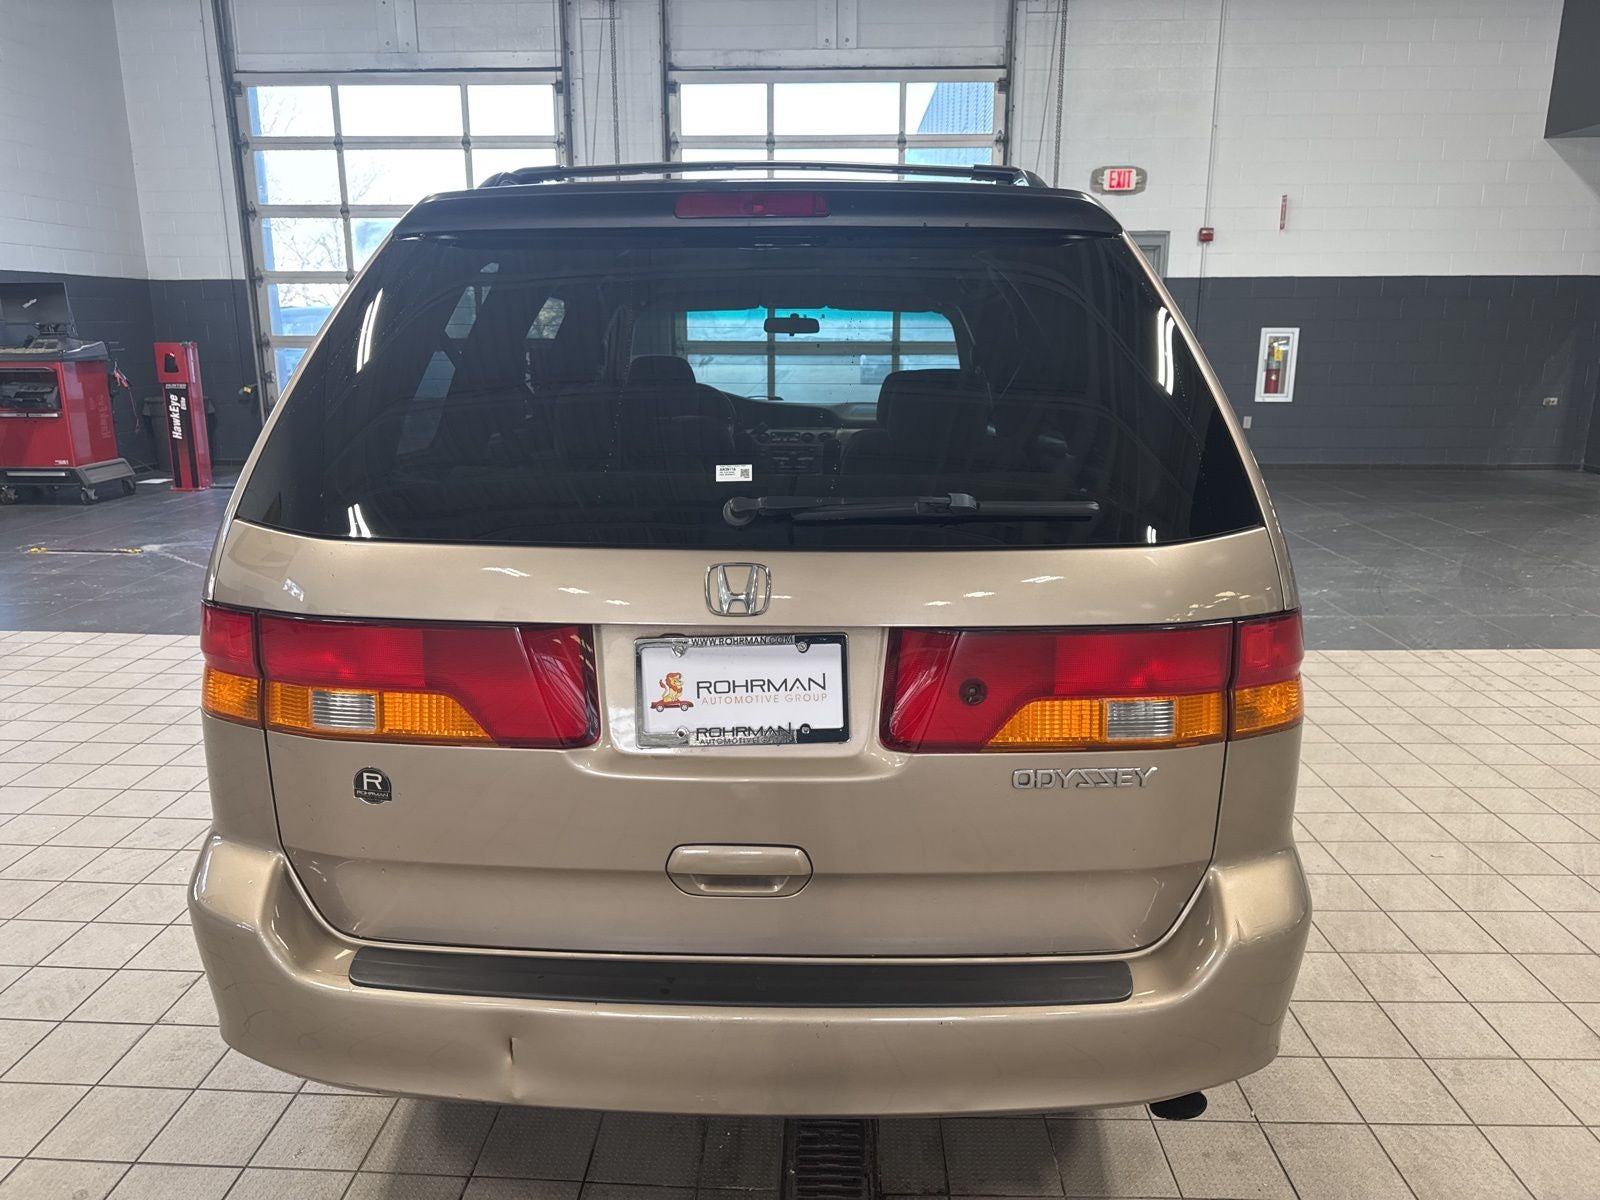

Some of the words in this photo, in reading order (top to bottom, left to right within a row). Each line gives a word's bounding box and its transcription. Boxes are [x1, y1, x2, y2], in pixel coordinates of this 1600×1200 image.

[1108, 170, 1133, 189] EXIT
[169, 393, 183, 440] HawkEye
[691, 635, 794, 647] WWW.ROHRMAN.COM
[696, 672, 827, 699] ROHRMAN
[701, 695, 780, 705] AUTOMOTIVE
[784, 693, 828, 703] GROUP
[696, 722, 792, 741] ROHRMAN
[362, 772, 383, 790] R
[1012, 766, 1158, 789] ODYSSEY
